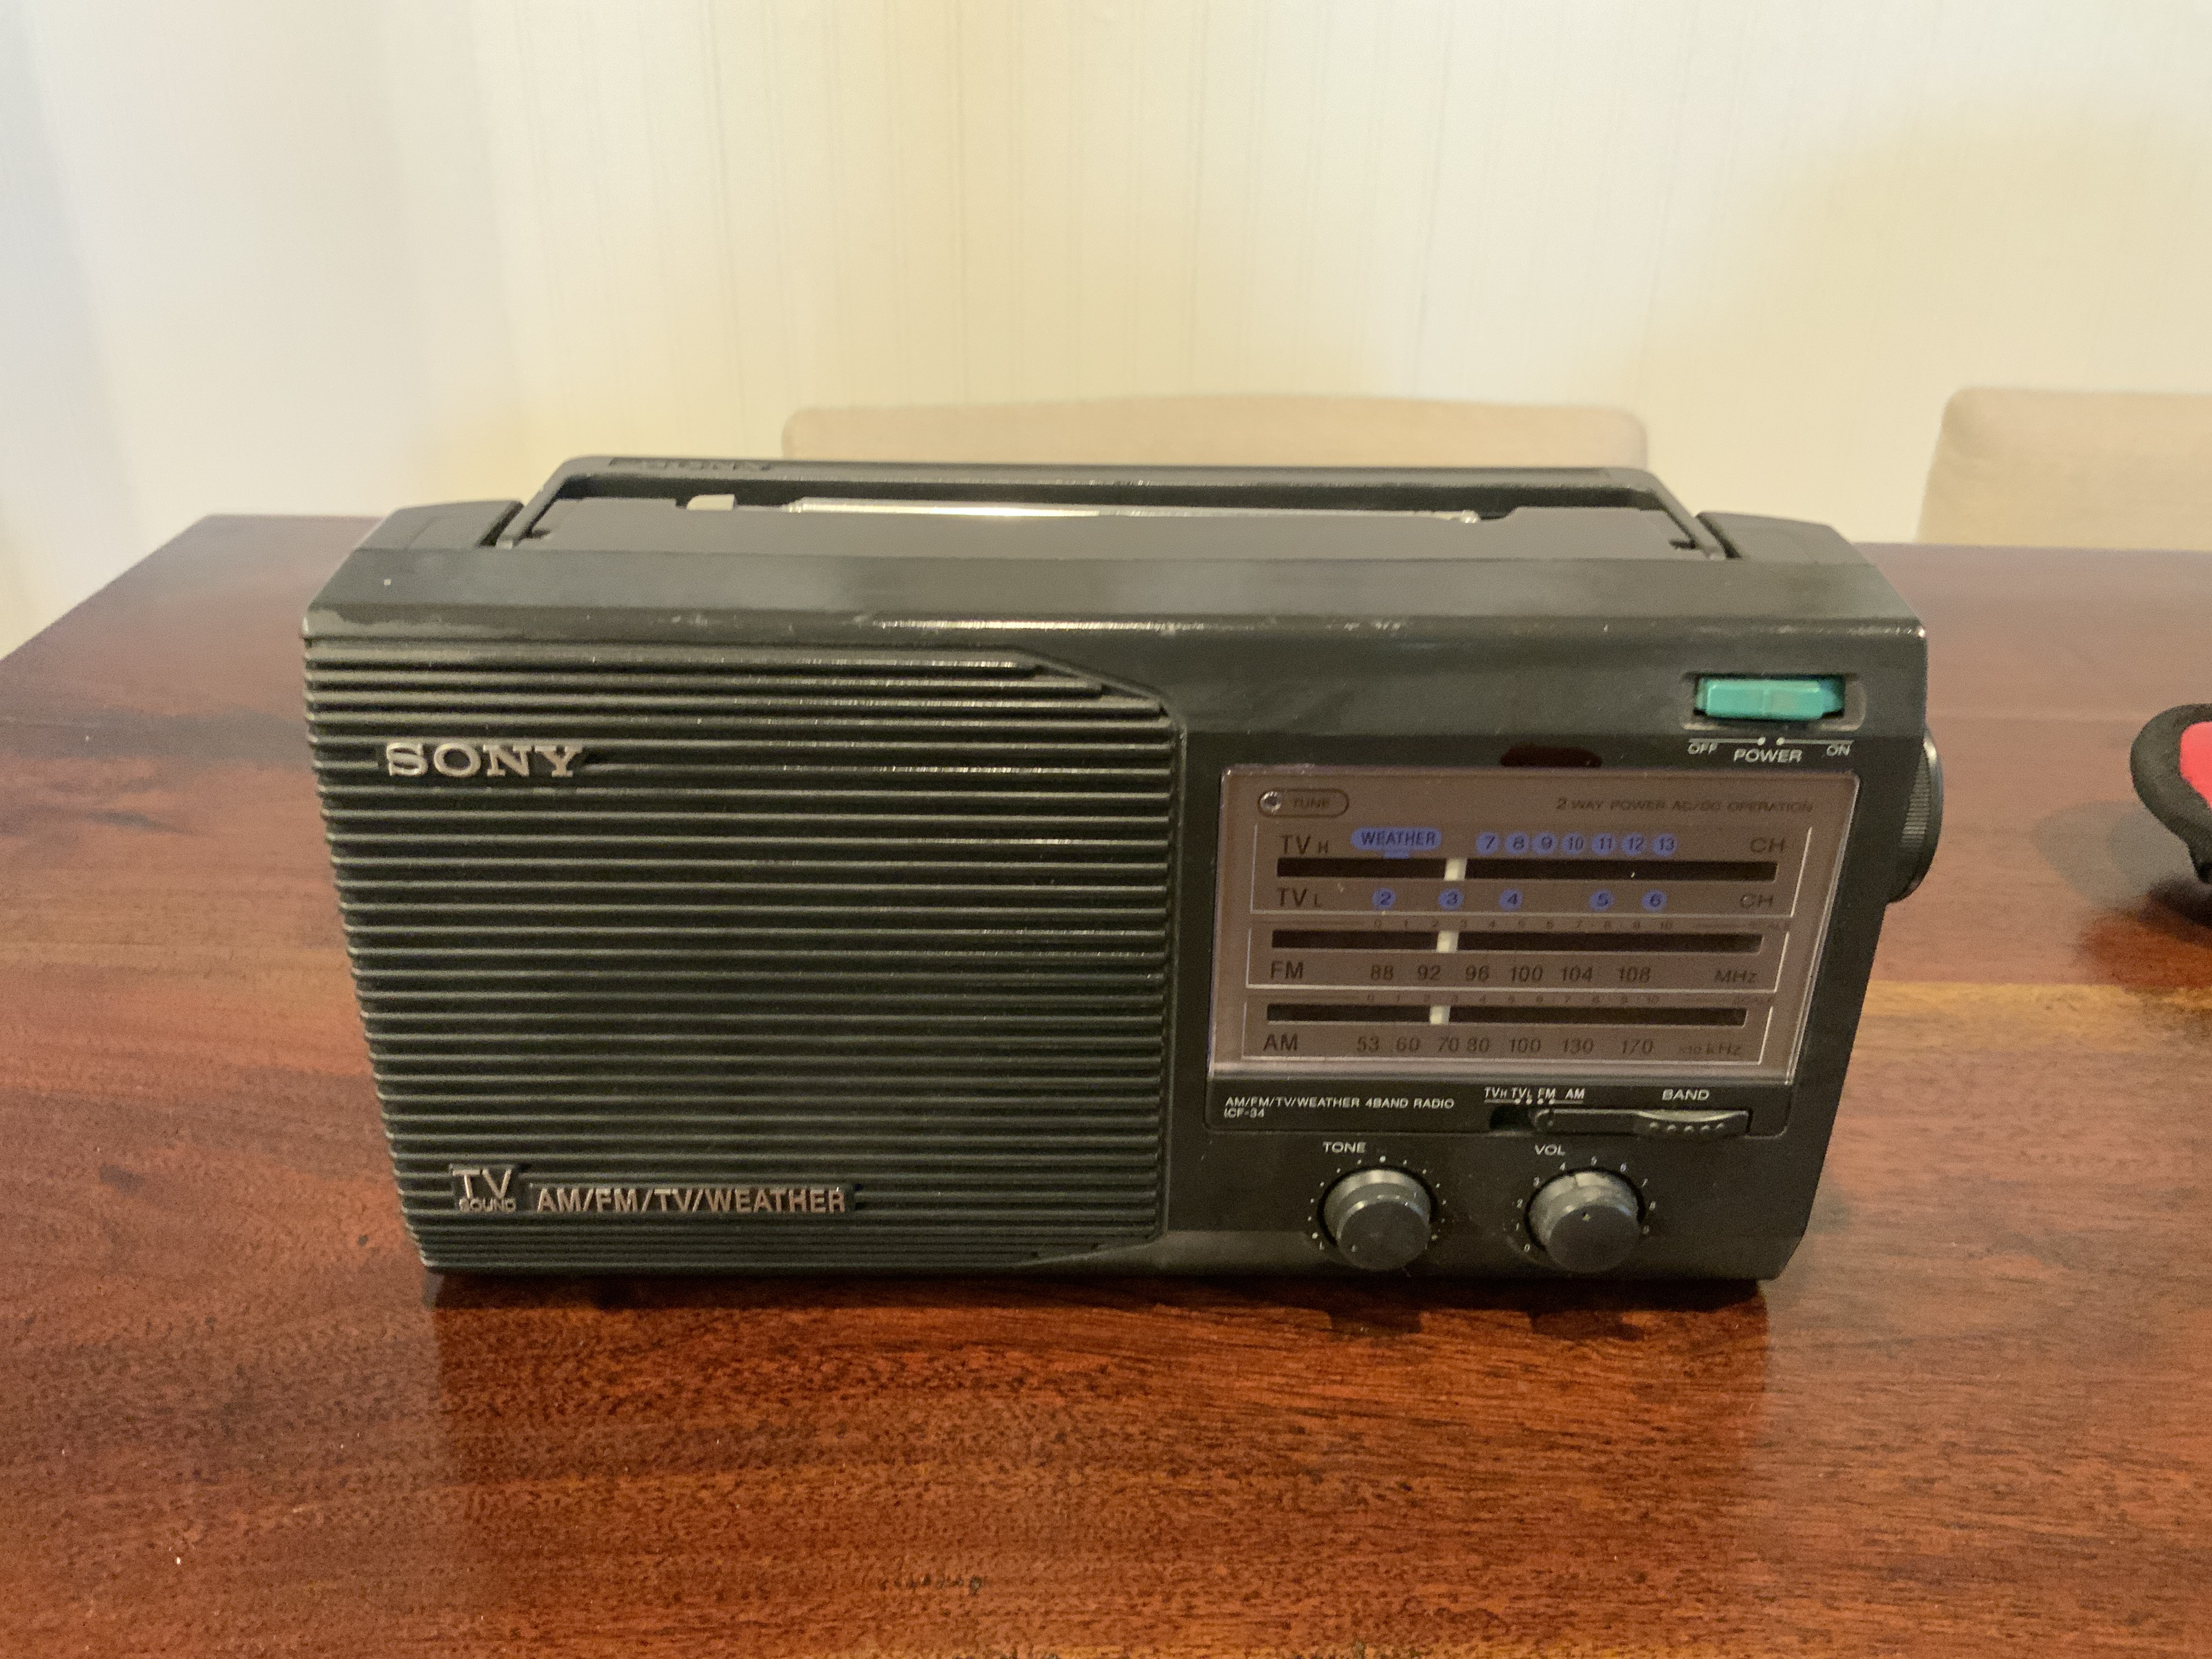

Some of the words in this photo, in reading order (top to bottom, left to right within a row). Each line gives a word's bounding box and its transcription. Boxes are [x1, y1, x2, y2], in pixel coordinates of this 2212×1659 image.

[1688, 742, 1718, 754] OFF
[1826, 743, 1850, 756] ON
[386, 742, 584, 778] SONY
[1733, 749, 1803, 763] POWER
[1556, 796, 1567, 811] 2
[1571, 799, 1604, 811] WAY
[1610, 800, 1666, 812] POWER
[1726, 800, 1814, 814] OPERATION
[1361, 831, 1437, 846] WEATHER
[1486, 836, 1496, 850] 7
[1513, 836, 1524, 850] 8
[1541, 836, 1552, 850] 9
[1568, 837, 1584, 850] 10
[1599, 837, 1612, 850] 11
[1628, 837, 1644, 850] 12
[1659, 837, 1675, 851] 13
[1750, 837, 1786, 854] CH
[1380, 892, 1392, 904] 2
[1447, 892, 1459, 905] 3
[1507, 893, 1518, 905] 4
[1598, 893, 1610, 906] 5
[1650, 893, 1661, 907] 6
[1740, 894, 1774, 909] CH
[1271, 961, 1304, 979] FM
[1370, 964, 1394, 981] 88
[1417, 964, 1441, 981] 92
[1465, 965, 1489, 982] 96
[1510, 966, 1543, 983] 100
[1561, 966, 1593, 982] 104
[1618, 966, 1651, 983] 108
[1714, 969, 1758, 983] MHz
[1263, 1033, 1299, 1052] AM
[1357, 1036, 1380, 1053] 53
[1396, 1037, 1420, 1053] 60
[1437, 1037, 1459, 1053] 70
[1466, 1037, 1491, 1054] 80
[1510, 1038, 1541, 1054] 100
[1563, 1038, 1593, 1054] 130
[1621, 1039, 1654, 1055] 170
[1537, 1087, 1556, 1099] FM
[1565, 1088, 1585, 1099] AM
[1662, 1089, 1711, 1101] BAND
[1225, 1096, 1361, 1108] AM/FM/TV/WEATHER
[1365, 1097, 1409, 1109] 4BAND
[1413, 1098, 1455, 1109] RADIO
[1323, 1141, 1367, 1153] TONE
[1534, 1144, 1566, 1156] VOL
[452, 1169, 512, 1199] TV
[459, 1197, 517, 1213] SOUND
[536, 1187, 845, 1214] AM/FM/TV/WEATHER
